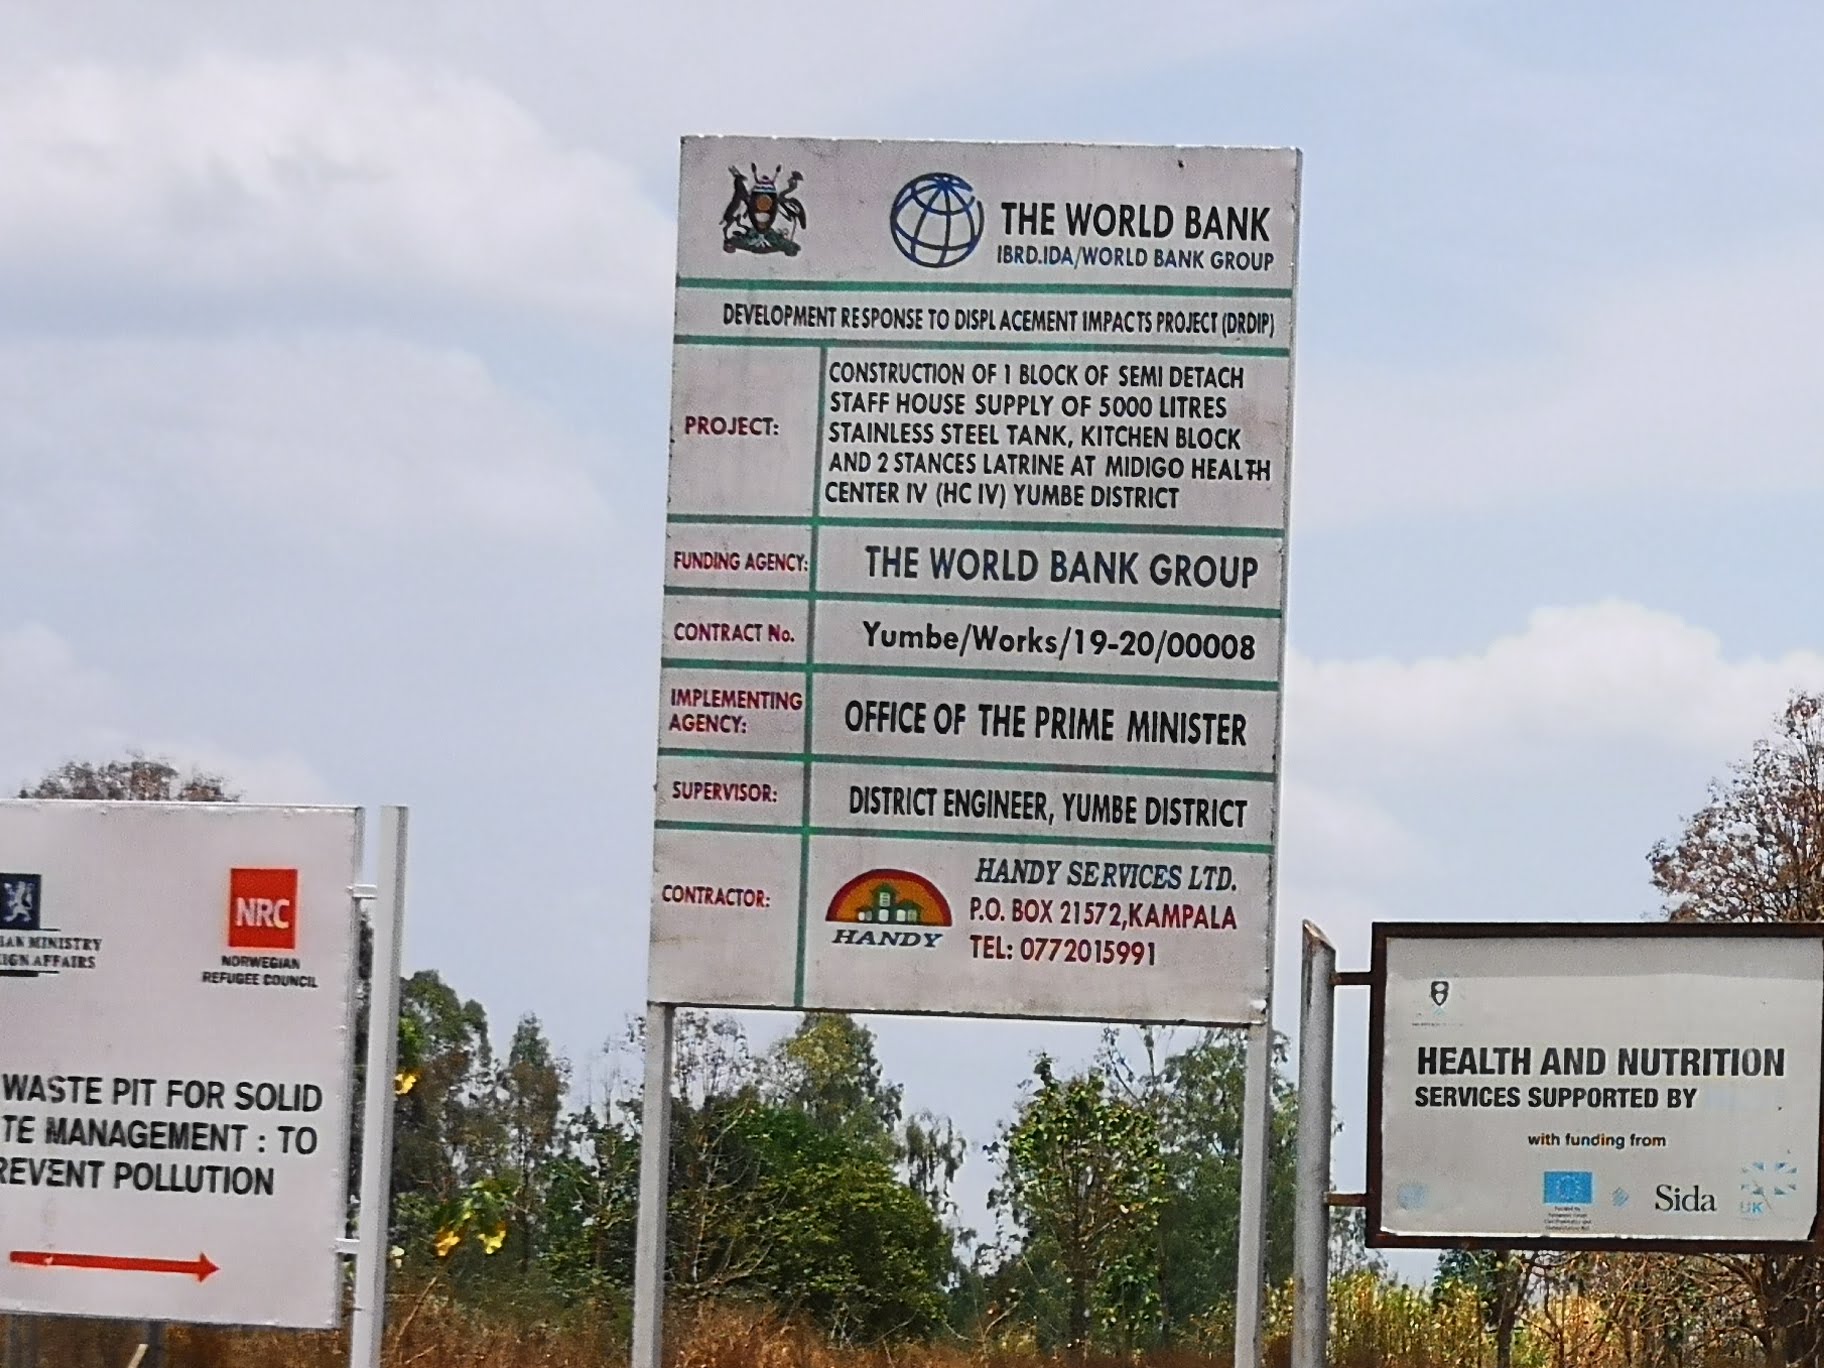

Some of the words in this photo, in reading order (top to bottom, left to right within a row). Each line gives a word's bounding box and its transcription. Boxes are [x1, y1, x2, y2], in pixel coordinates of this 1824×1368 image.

[1001, 202, 1055, 235] THE
[1066, 203, 1173, 238] WORLD
[1185, 206, 1270, 241] BANK
[998, 245, 1147, 269] IBRD.IDA/WORLD
[1154, 249, 1204, 268] BANK
[1211, 251, 1274, 271] GROUP
[829, 362, 964, 385] CONSTRUCTION
[972, 364, 996, 384] OF
[1004, 364, 1011, 383] 1
[1020, 364, 1078, 385] BLOCK
[1085, 365, 1108, 385] OF
[1119, 365, 1162, 387] SEMI
[1170, 366, 1243, 388] DETACH
[831, 391, 889, 413] STAFF
[897, 393, 965, 414] HOUSE
[975, 394, 1053, 416] SUPPLY
[1062, 396, 1091, 417] OF
[1099, 396, 1152, 417] 5000
[1160, 396, 1226, 418] LITRES
[685, 416, 778, 435] PROJECT:
[829, 422, 933, 444] STAINLESS
[941, 423, 999, 444] STEEL
[1007, 425, 1073, 448] TANK,
[1082, 426, 1168, 448] KITCHEN
[1176, 427, 1240, 450] BLOCK
[829, 452, 871, 472] AND
[878, 452, 888, 473] 2
[894, 452, 976, 474] STANCES
[984, 454, 1064, 476] LATRINE
[1071, 455, 1096, 476] AT
[1105, 456, 1184, 478] MIDIGO
[1192, 458, 1270, 481] HEALTH
[825, 482, 899, 503] CENTER
[907, 483, 927, 503] IV
[937, 482, 971, 507] (HC
[979, 484, 1005, 509] IV)
[1014, 484, 1085, 506] YUMBE
[1091, 486, 1179, 508] DISTRICT
[674, 551, 740, 570] FUNDING
[745, 553, 807, 571] AGENCY:
[865, 546, 918, 578] THE
[930, 547, 1038, 581] WORLD
[1051, 550, 1138, 584] BANK
[1150, 554, 1258, 588] GROUP
[674, 623, 763, 641] CONTRACT
[768, 624, 794, 642] No.
[863, 621, 1255, 663] Yumbe/Works/19-20/00008
[671, 689, 802, 710] IMPLEMENTING
[669, 714, 746, 733] AGENCY:
[845, 700, 926, 733] OFFICE
[934, 703, 965, 734] OF
[978, 704, 1025, 737] THE
[1036, 706, 1114, 741] PRIME
[1127, 711, 1246, 746] MINISTER
[673, 781, 777, 802] SUPERVISOR:
[850, 786, 937, 816] DISTRICT
[944, 789, 1054, 825] ENGINEER,
[1063, 793, 1137, 824] YUMBE
[1146, 797, 1247, 827] DISTRICT
[975, 858, 1062, 885] HANDY
[1067, 861, 1182, 889] SERVICES
[1188, 866, 1236, 891] LTD.
[662, 885, 770, 907] CONTRACTOR:
[236, 897, 289, 928] NRC
[970, 897, 1005, 921] P.O.
[1012, 898, 1053, 923] BOX
[1061, 901, 1237, 931] 21572,KAMPALA
[28, 937, 102, 951] MINISTRY
[832, 930, 943, 947] HANDY
[970, 935, 1012, 959] TEL:
[1021, 938, 1154, 965] 0772015991
[32, 955, 95, 968] AFFAIRS
[222, 956, 300, 969] NORWEGIAN
[202, 972, 260, 985] REFUGEE
[263, 974, 318, 988] COUNCIL
[1418, 1047, 1531, 1075] HEALTH
[1540, 1048, 1605, 1075] AND
[1618, 1048, 1784, 1076] NUTRITION
[3, 1074, 102, 1104] WASTE
[113, 1078, 156, 1106] PIT
[167, 1080, 224, 1109] FOR
[235, 1082, 322, 1112] SOLID
[1415, 1087, 1520, 1107] SERVICES
[1528, 1087, 1658, 1108] SUPPORTED
[1668, 1088, 1697, 1108] BY
[2, 1115, 35, 1143] TE
[45, 1117, 248, 1152] MANAGEMENT
[278, 1126, 317, 1154] TO
[1528, 1133, 1560, 1145] with
[1565, 1133, 1625, 1149] funding
[1630, 1134, 1666, 1146] from
[114, 1162, 273, 1195] POLLUTION
[1655, 1184, 1716, 1211] Sida
